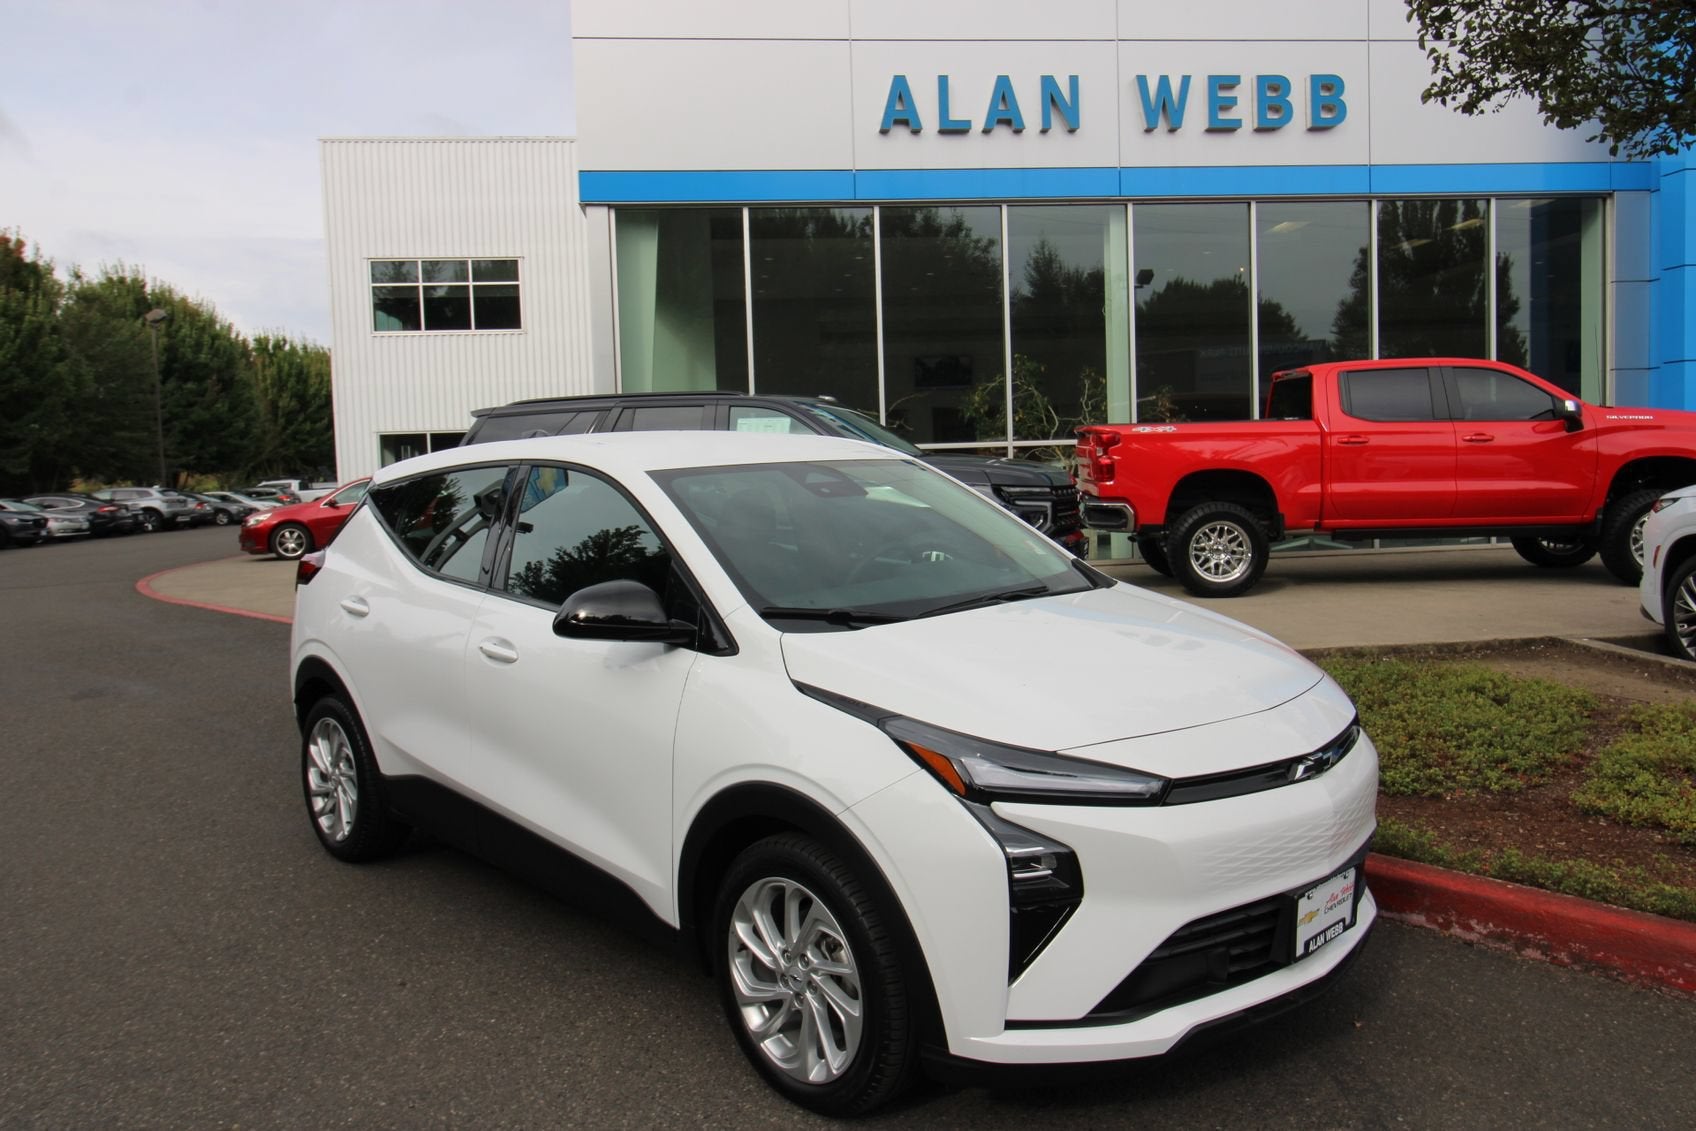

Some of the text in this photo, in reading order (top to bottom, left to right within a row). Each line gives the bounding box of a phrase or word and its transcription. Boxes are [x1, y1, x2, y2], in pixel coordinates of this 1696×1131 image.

[879, 75, 1348, 135] ALAN WEBB
[1324, 893, 1353, 914] CHEVROLET
[1308, 922, 1344, 953] ALAN WEBB
